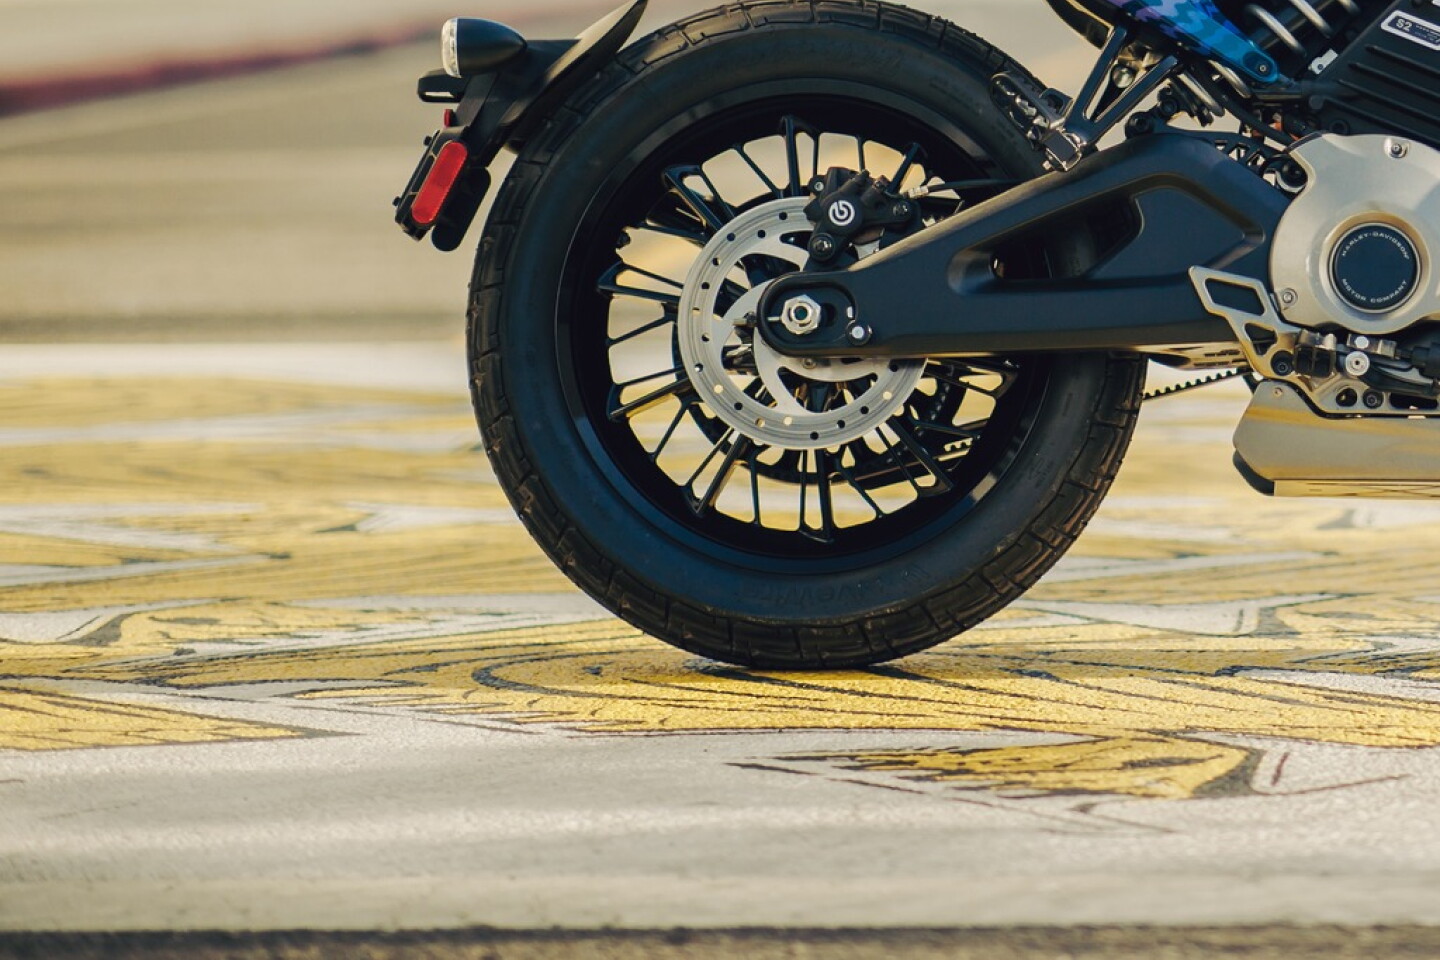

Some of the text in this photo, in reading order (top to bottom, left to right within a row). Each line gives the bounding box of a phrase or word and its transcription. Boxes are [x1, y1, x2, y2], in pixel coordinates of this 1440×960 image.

[1396, 18, 1412, 32] S2
[1342, 231, 1409, 259] HARLEY-DAVIDSON
[1342, 279, 1407, 303] MOTOR COMPANY
